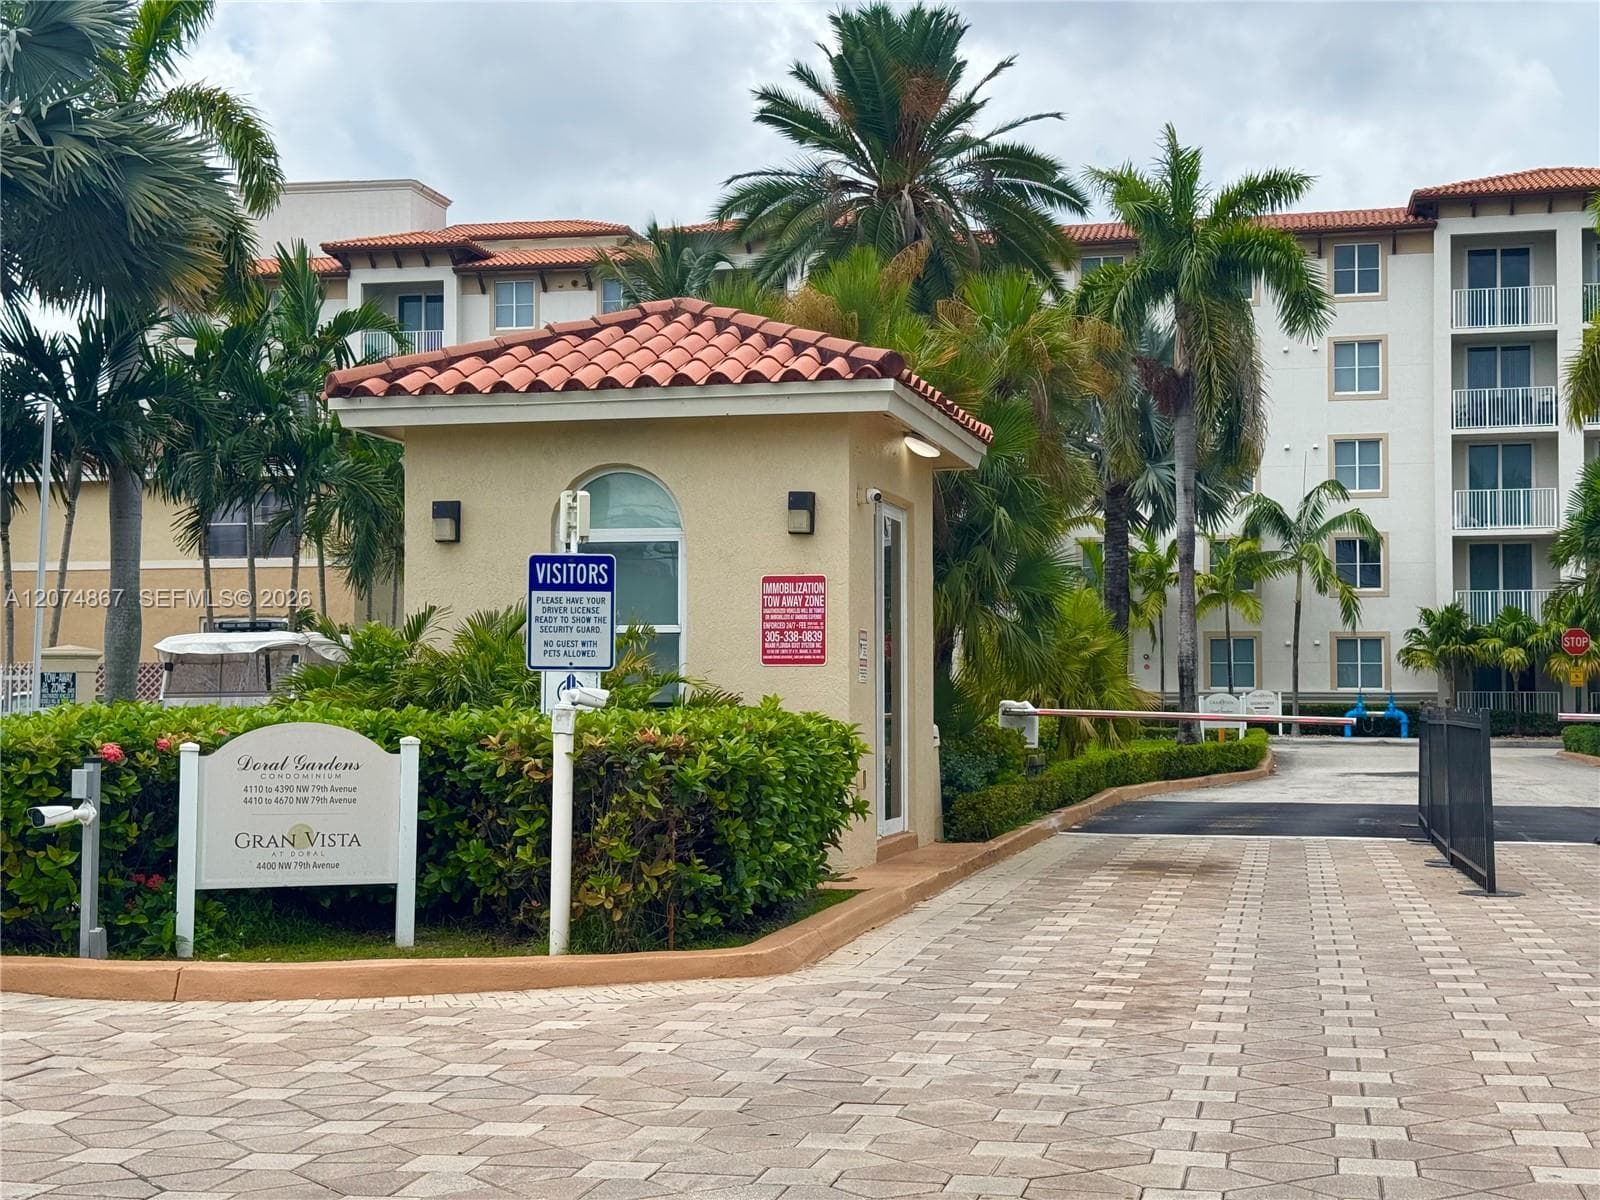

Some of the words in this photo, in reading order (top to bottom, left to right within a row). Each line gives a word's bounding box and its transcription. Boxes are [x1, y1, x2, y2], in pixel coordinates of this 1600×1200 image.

[536, 563, 608, 584] VISITORS
[763, 582, 824, 594] IMMOBILIZATION
[763, 596, 780, 607] TOW
[782, 596, 803, 607] AWAY
[805, 596, 824, 607] ZONE
[765, 631, 822, 642] 305-338-0839
[1564, 637, 1588, 647] STOP
[50, 683, 66, 693] ZONE
[237, 754, 289, 771] Doral
[294, 754, 364, 771] Gardens
[243, 785, 263, 793] 4110
[265, 785, 272, 793] to
[274, 785, 294, 793] 4390
[296, 785, 309, 793] NW
[311, 785, 328, 793] 79th
[330, 785, 357, 793] Avenue
[235, 832, 296, 849] GRAN
[304, 832, 362, 849] VISTA
[256, 862, 276, 870] 4400
[278, 862, 292, 870] NW
[293, 862, 310, 870] 79th
[312, 862, 340, 870] Avenue
